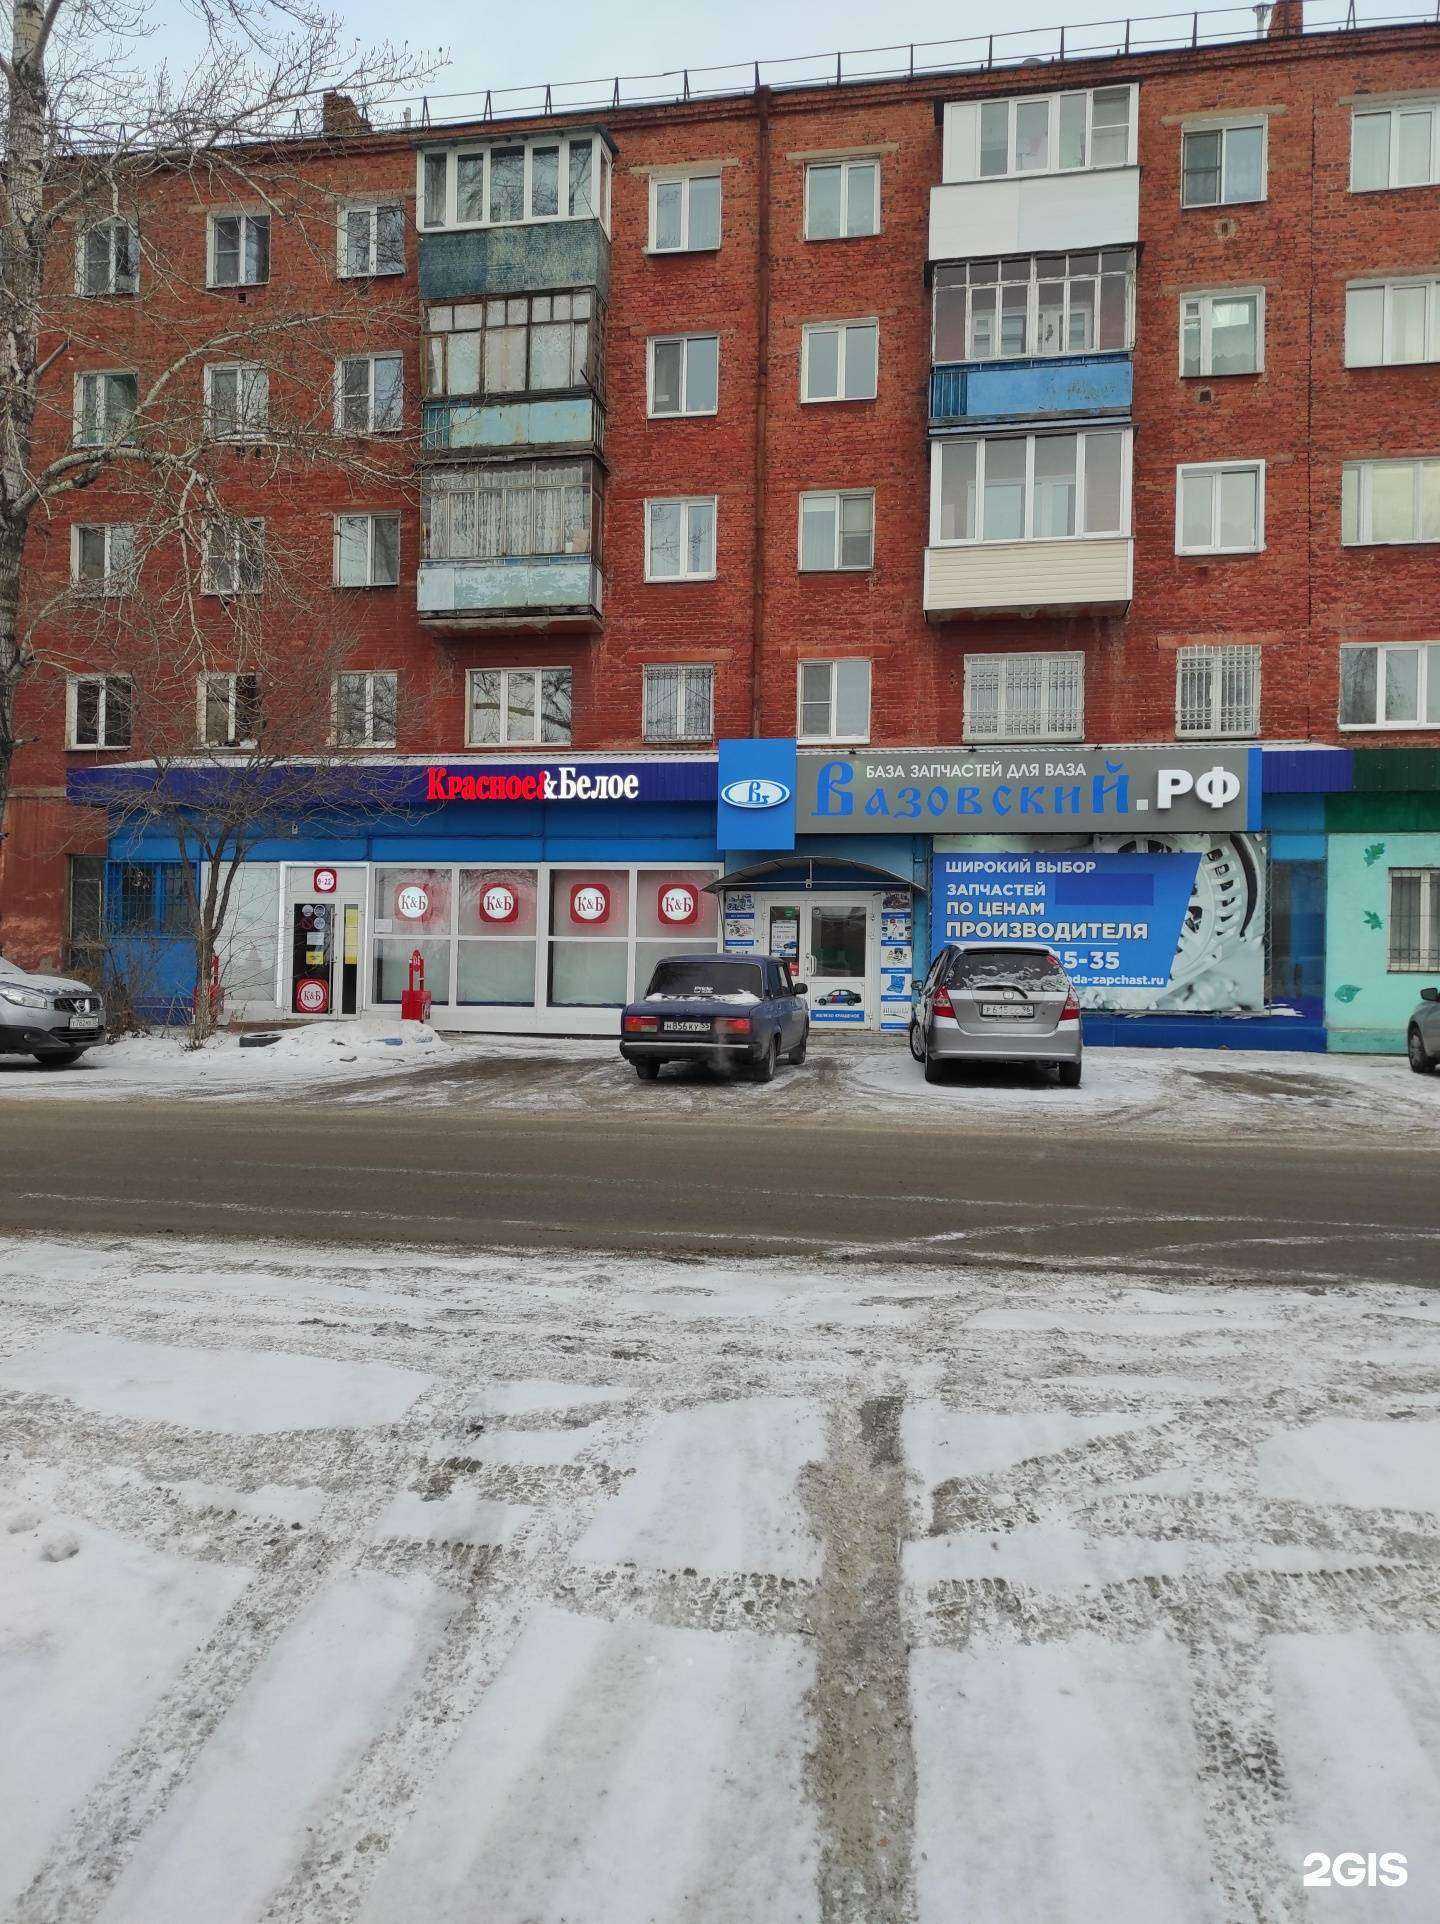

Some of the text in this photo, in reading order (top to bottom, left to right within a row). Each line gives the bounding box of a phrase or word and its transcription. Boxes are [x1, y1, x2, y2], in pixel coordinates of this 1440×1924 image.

[866, 760, 1087, 779] БАЗА ЗАПЧАСТЕЙ ДЛЯ ВАЗА
[945, 857, 1097, 874] ШИРОКИЙ ВЫБОР
[946, 881, 1047, 897] ЗАПЧАСТЕЙ
[486, 895, 512, 911] К&Б
[577, 896, 604, 912] К&Б
[664, 896, 692, 912] К&Б
[946, 902, 1045, 919] ПО ЦЕНАМ
[946, 921, 1149, 943] ПРОИЗВОДИТЕЛЯ
